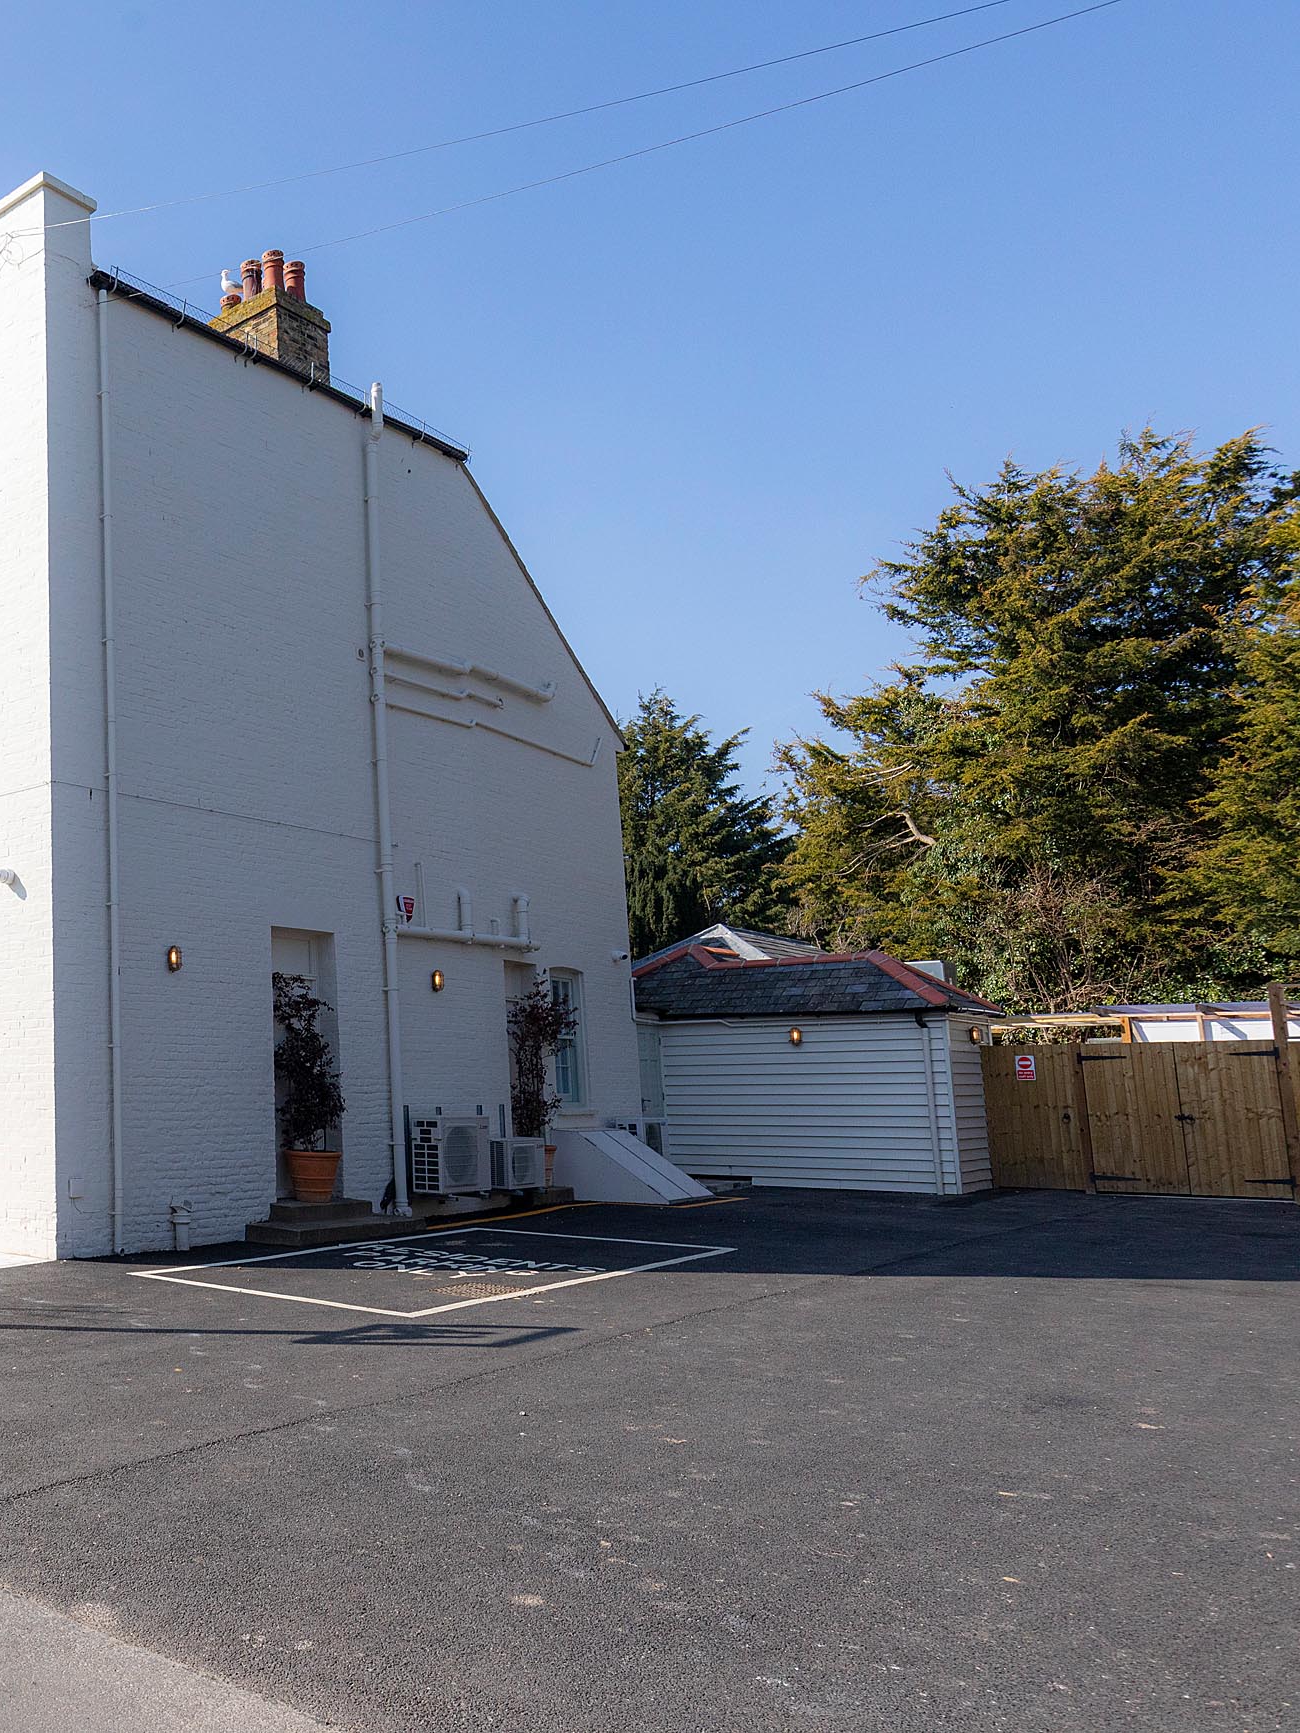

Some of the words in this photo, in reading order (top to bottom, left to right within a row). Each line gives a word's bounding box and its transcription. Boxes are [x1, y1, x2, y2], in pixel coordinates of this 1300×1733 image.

[342, 1251, 539, 1275] PARKING
[353, 1261, 486, 1278] ONLY
[356, 1244, 606, 1273] RESIDENTS
